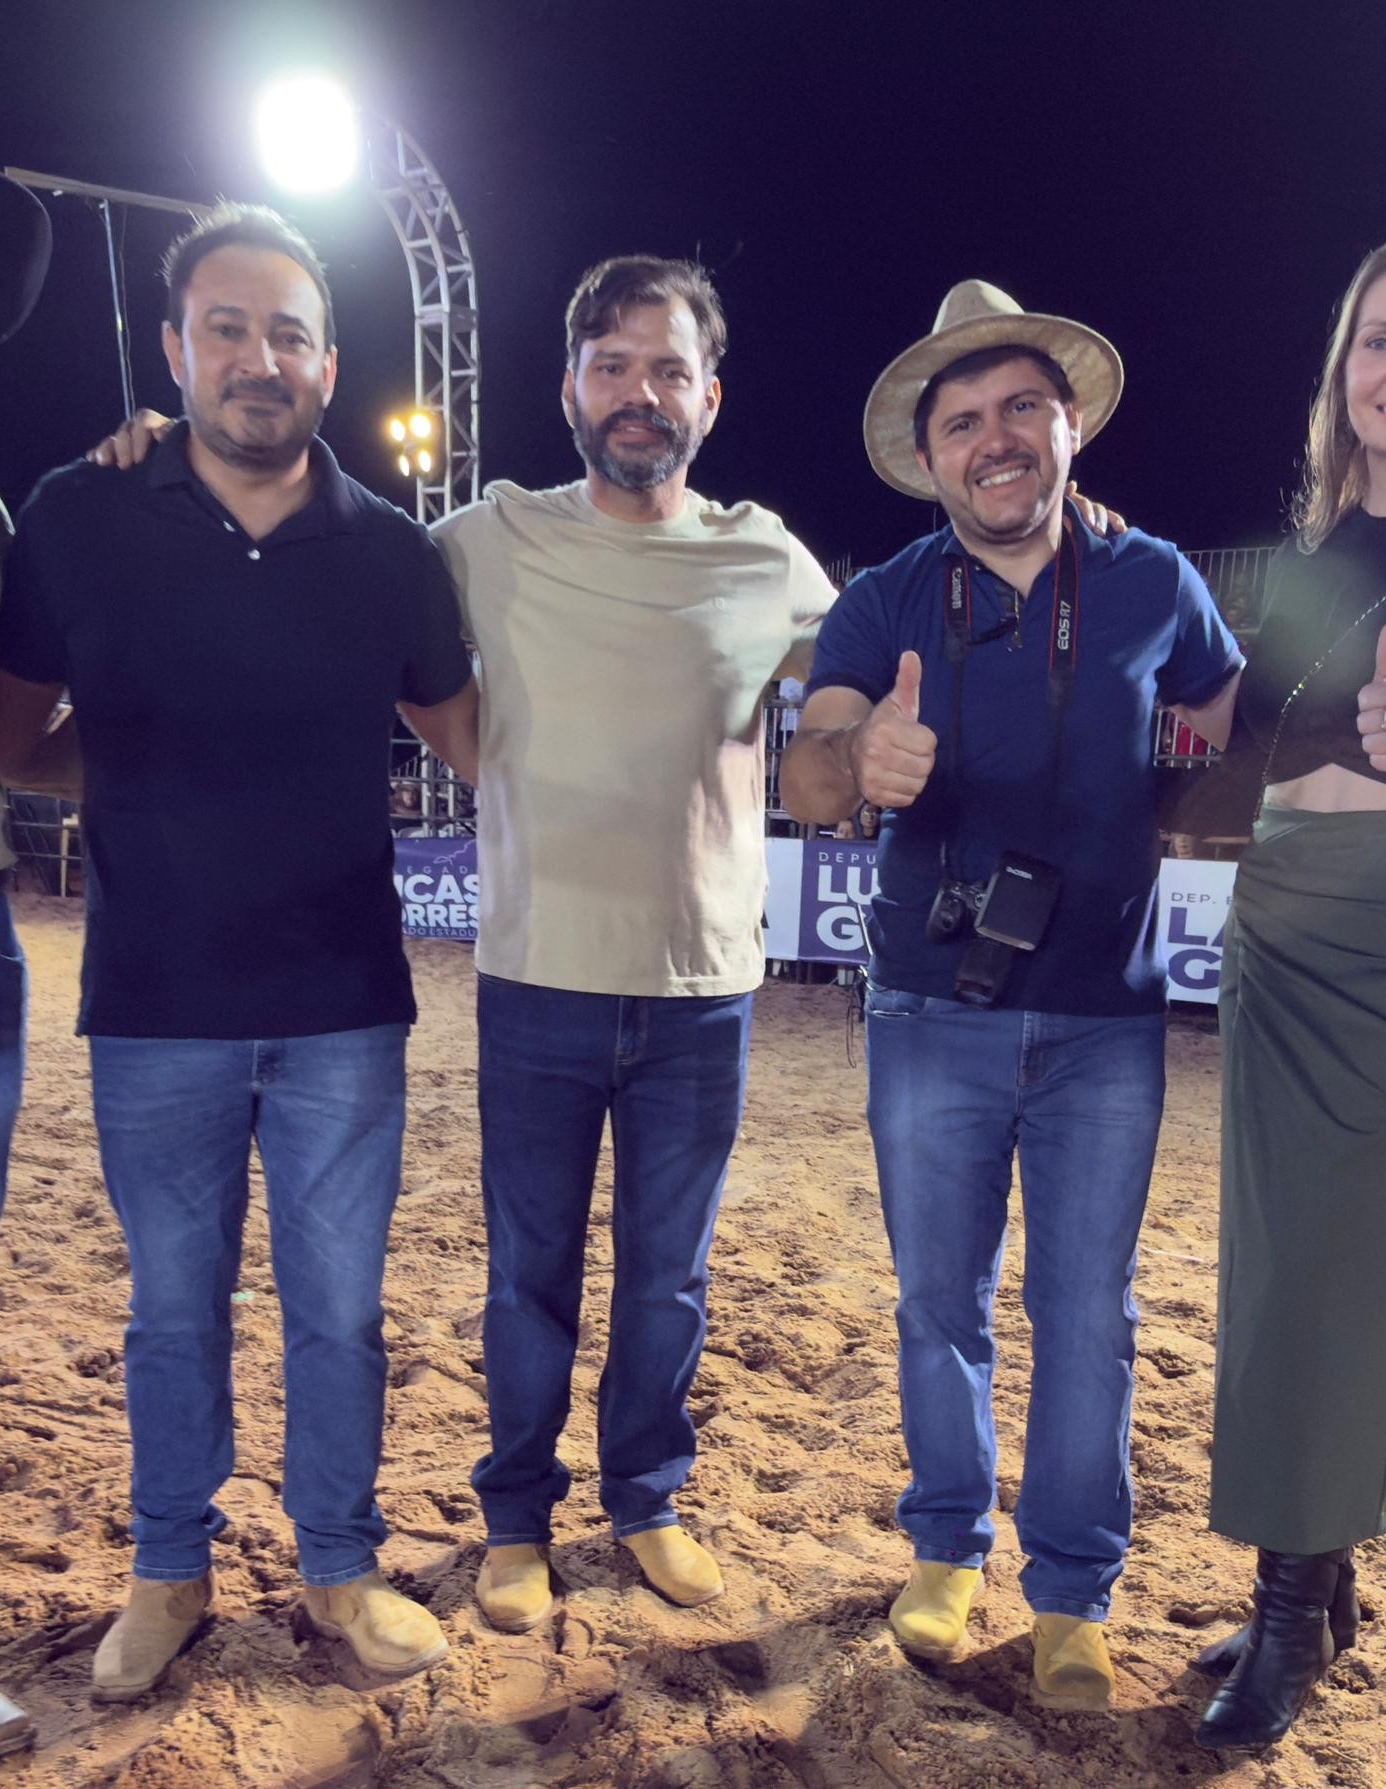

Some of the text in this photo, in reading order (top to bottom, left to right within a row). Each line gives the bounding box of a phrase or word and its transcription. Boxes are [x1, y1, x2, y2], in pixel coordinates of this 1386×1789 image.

[1057, 618, 1070, 650] EOS
[406, 865, 469, 875] EGAD
[818, 852, 876, 865] DEPU
[817, 864, 882, 906] LU
[1171, 892, 1217, 904] DEP.
[401, 904, 480, 929] RRES
[816, 905, 865, 951] G
[1167, 906, 1224, 948] L
[430, 928, 476, 938] ESTADU
[1168, 948, 1224, 991] G
